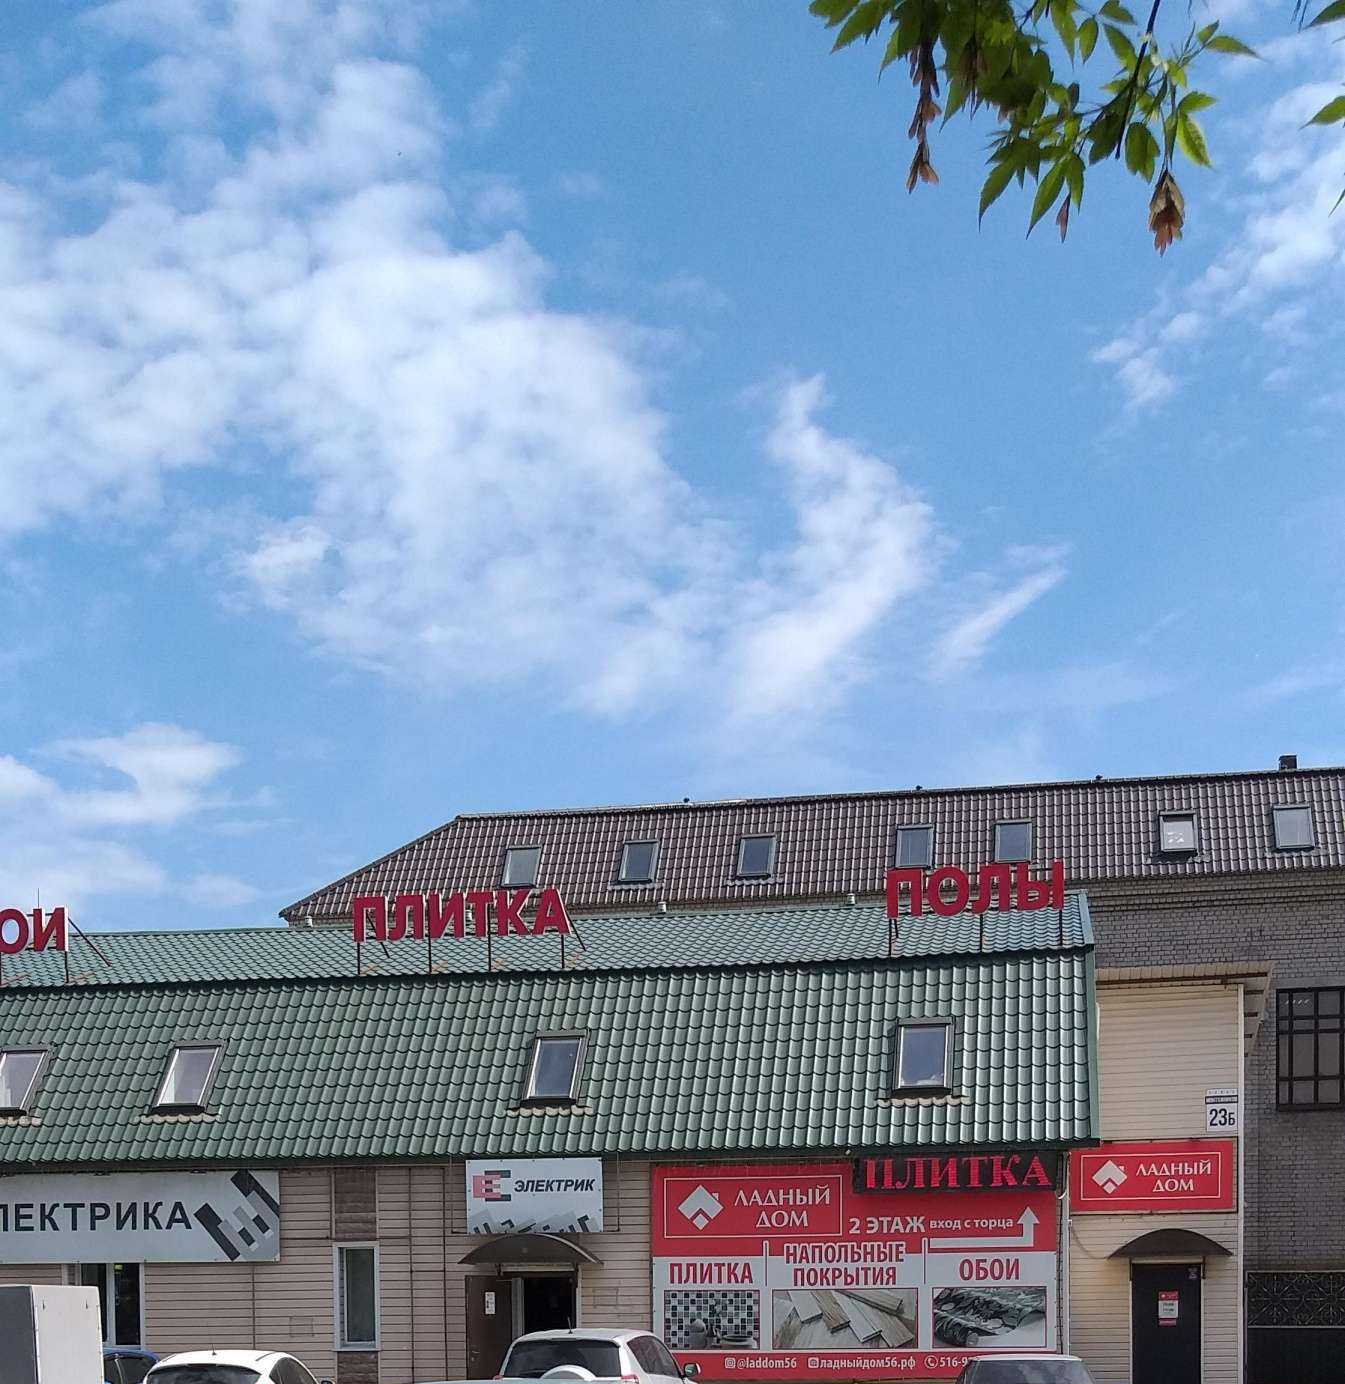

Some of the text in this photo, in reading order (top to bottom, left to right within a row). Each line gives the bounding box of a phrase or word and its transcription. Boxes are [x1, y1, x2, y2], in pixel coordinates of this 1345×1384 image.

[886, 858, 1065, 919] ПОЛЫ
[353, 886, 572, 943] ПЛИТКА
[864, 1154, 1052, 1190] ПЛИТКА
[1136, 1159, 1212, 1176] ЛАДНЫЙ
[513, 1178, 596, 1193] ЭЛЕКТРИК
[734, 1184, 830, 1207] ЛАДНЫЙ
[1153, 1178, 1195, 1193] ДОМ
[755, 1210, 809, 1228] ДОМ
[848, 1215, 1013, 1235] 2 ЭТАЖ вход с торца
[784, 1243, 905, 1264] НАПОЛЬНЫЕ
[669, 1262, 753, 1284] ПЛИТКА
[793, 1266, 897, 1287] ПОКРЫТИЯ
[959, 1258, 1021, 1281] ОБОИ
[736, 1356, 797, 1369] @laddom56
[939, 1356, 969, 1367] 516-9
